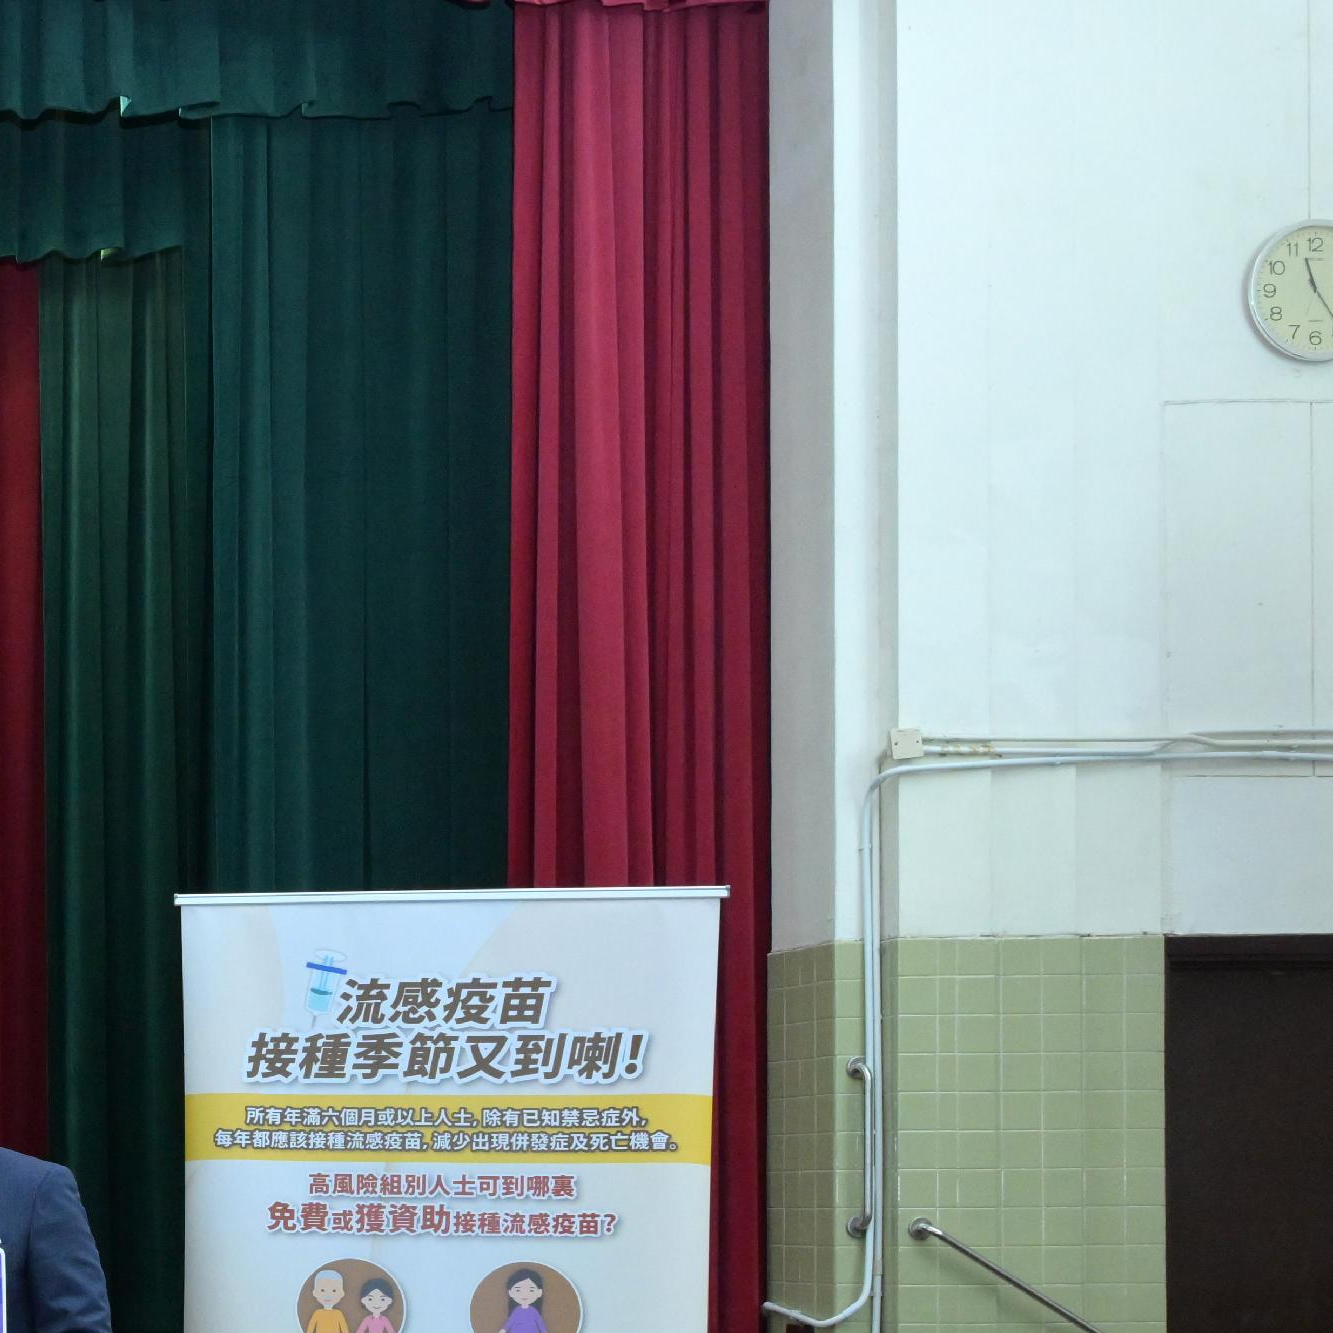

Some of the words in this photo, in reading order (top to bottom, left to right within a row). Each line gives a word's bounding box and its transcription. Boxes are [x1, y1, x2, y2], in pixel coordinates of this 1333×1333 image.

[1287, 242, 1299, 257] 11
[1307, 238, 1324, 252] 12
[1268, 260, 1286, 275] 10
[1263, 283, 1277, 298] 9
[1269, 306, 1283, 321] 8
[1288, 324, 1301, 339] 7
[1309, 331, 1322, 346] 6
[336, 977, 553, 1025] 流感疫苗
[245, 1032, 645, 1081] 接種季節又到喇!
[308, 1173, 576, 1198] 高風險組別人士可到哪裏
